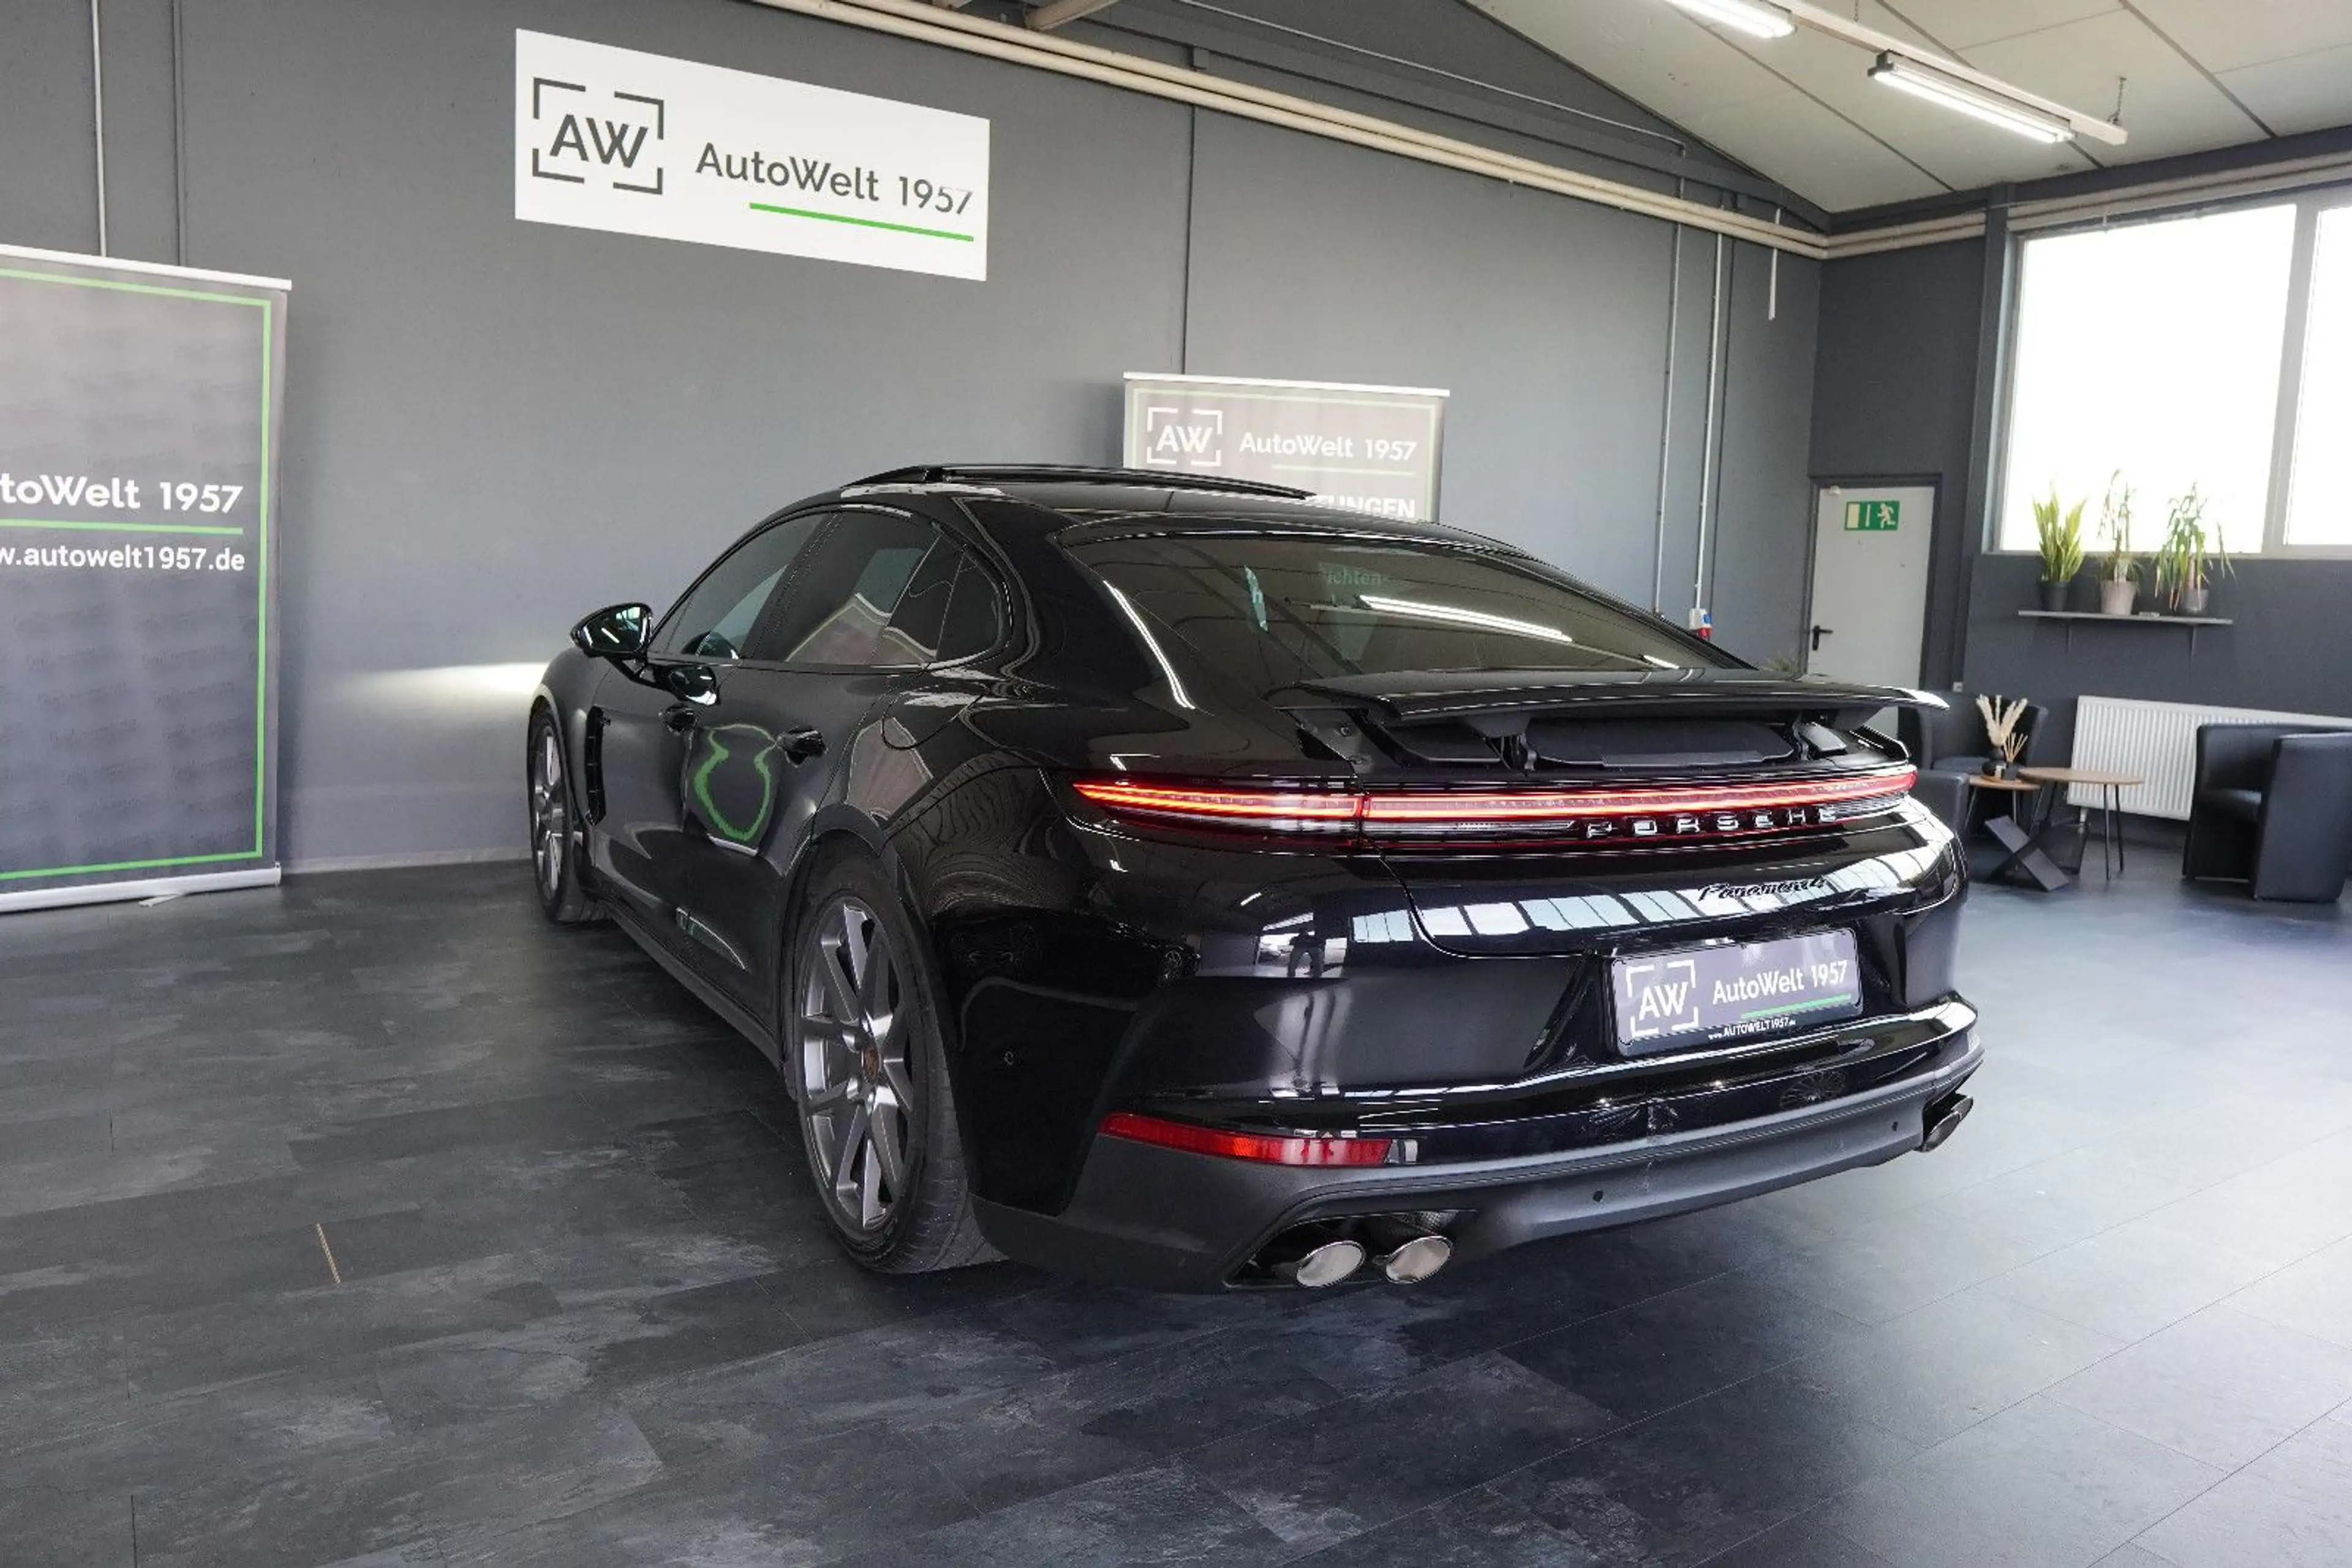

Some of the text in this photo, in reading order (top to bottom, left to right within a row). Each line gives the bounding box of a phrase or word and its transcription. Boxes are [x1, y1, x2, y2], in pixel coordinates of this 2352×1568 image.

[549, 113, 649, 169] AW
[695, 141, 973, 216] AutoWelt 1957
[1156, 424, 1213, 454] AW
[1239, 432, 1418, 461] AutoWelt 1957
[0, 472, 244, 514] toWelt 1957
[1586, 804, 1838, 839] PORSCHE
[1638, 981, 1689, 1021] AW
[1713, 959, 1847, 1005] AutoWelt 1957
